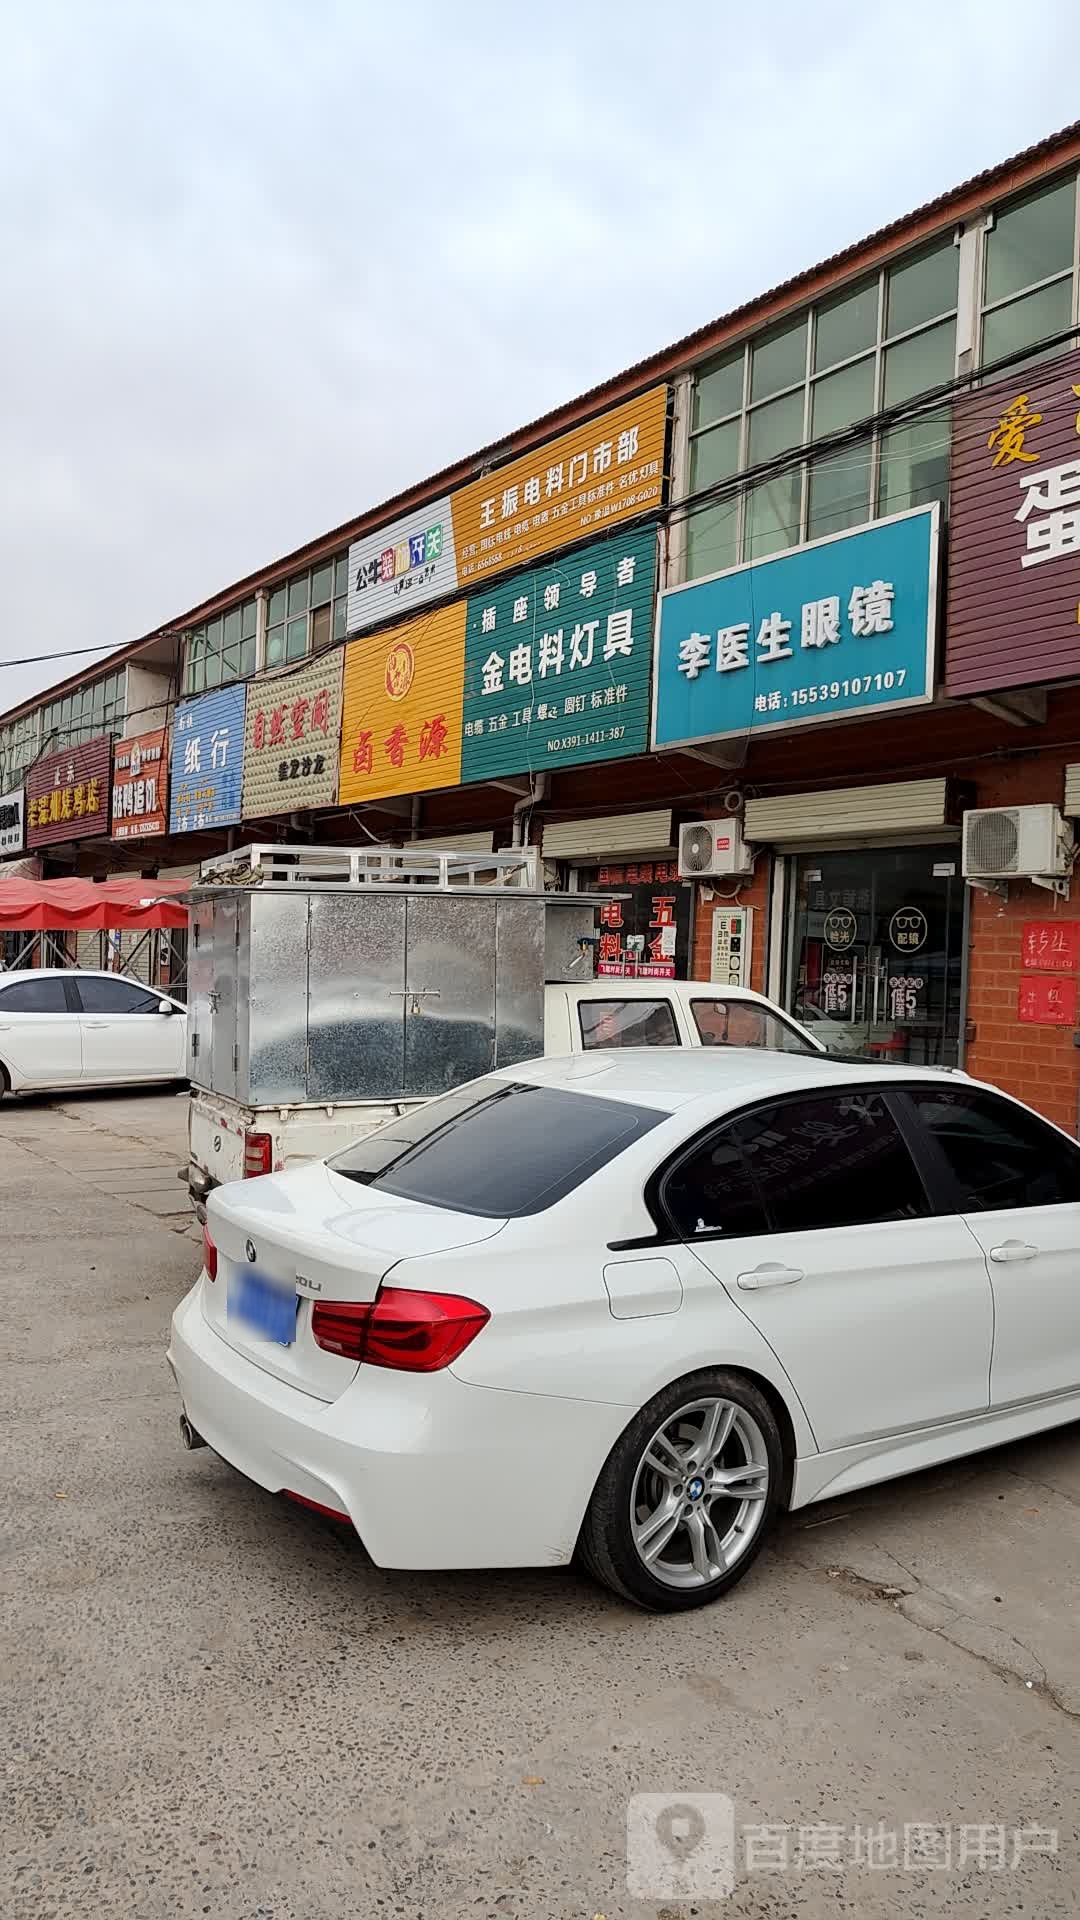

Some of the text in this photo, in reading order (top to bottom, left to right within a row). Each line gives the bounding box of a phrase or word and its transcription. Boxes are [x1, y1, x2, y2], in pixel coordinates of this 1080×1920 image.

[480, 425, 640, 531] 王振电料门市部
[620, 460, 659, 488] 名优灯具
[481, 556, 637, 634] 插座领导者
[481, 609, 634, 695] 金电料灯具
[677, 580, 895, 680] 李医生眼镜
[464, 719, 484, 737] 电缆
[488, 713, 508, 733] 五金
[512, 707, 531, 728] 工具
[564, 693, 586, 715] 圆钉
[591, 683, 628, 710] 标准件
[184, 728, 229, 774] 纸行
[897, 932, 919, 945] 配镜
[1027, 930, 1071, 954] 转让
